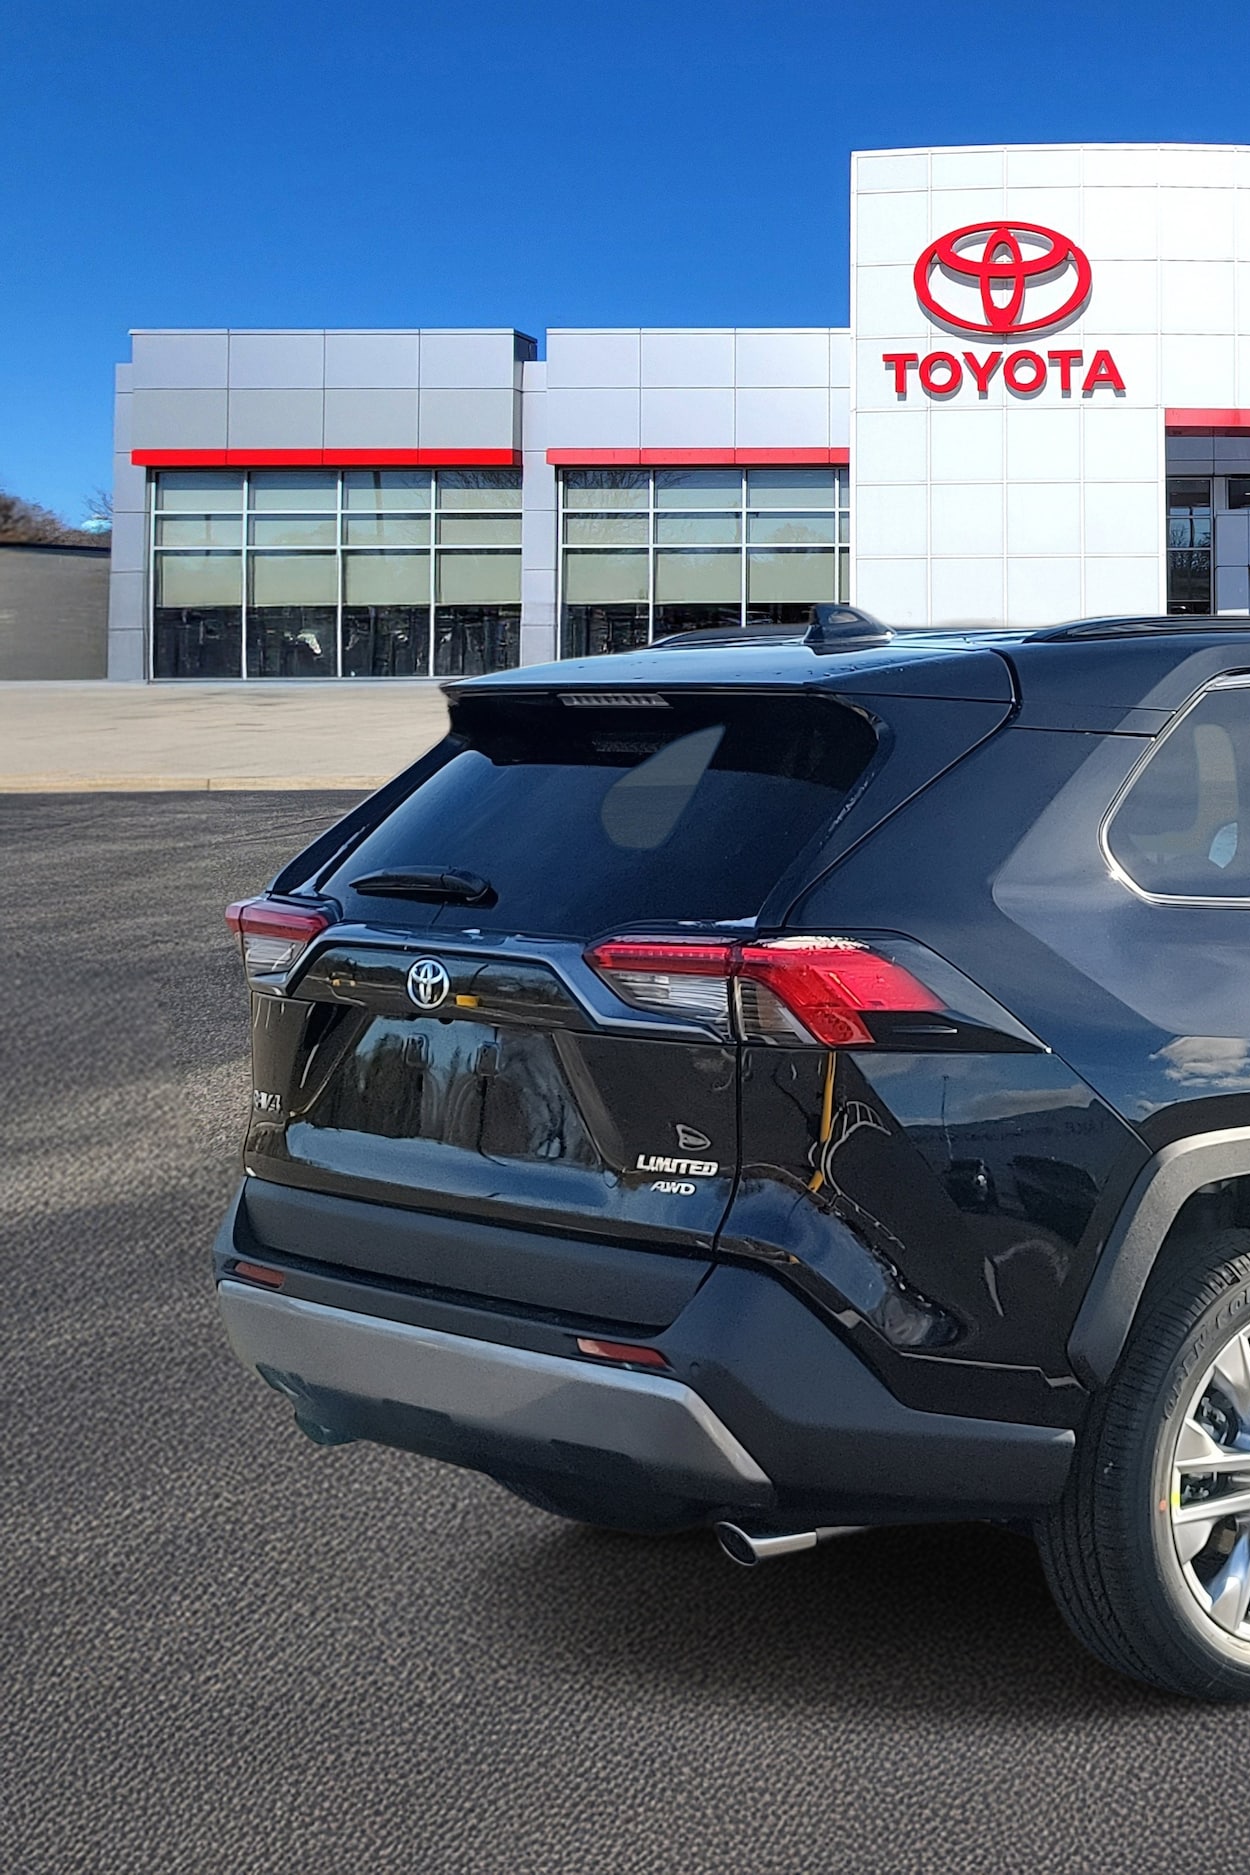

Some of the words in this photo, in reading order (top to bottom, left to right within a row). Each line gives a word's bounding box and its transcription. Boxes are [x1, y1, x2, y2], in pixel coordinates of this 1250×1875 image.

[882, 349, 1127, 398] TOYOTA
[636, 1153, 719, 1177] LIMITED
[650, 1180, 696, 1196] AWD
